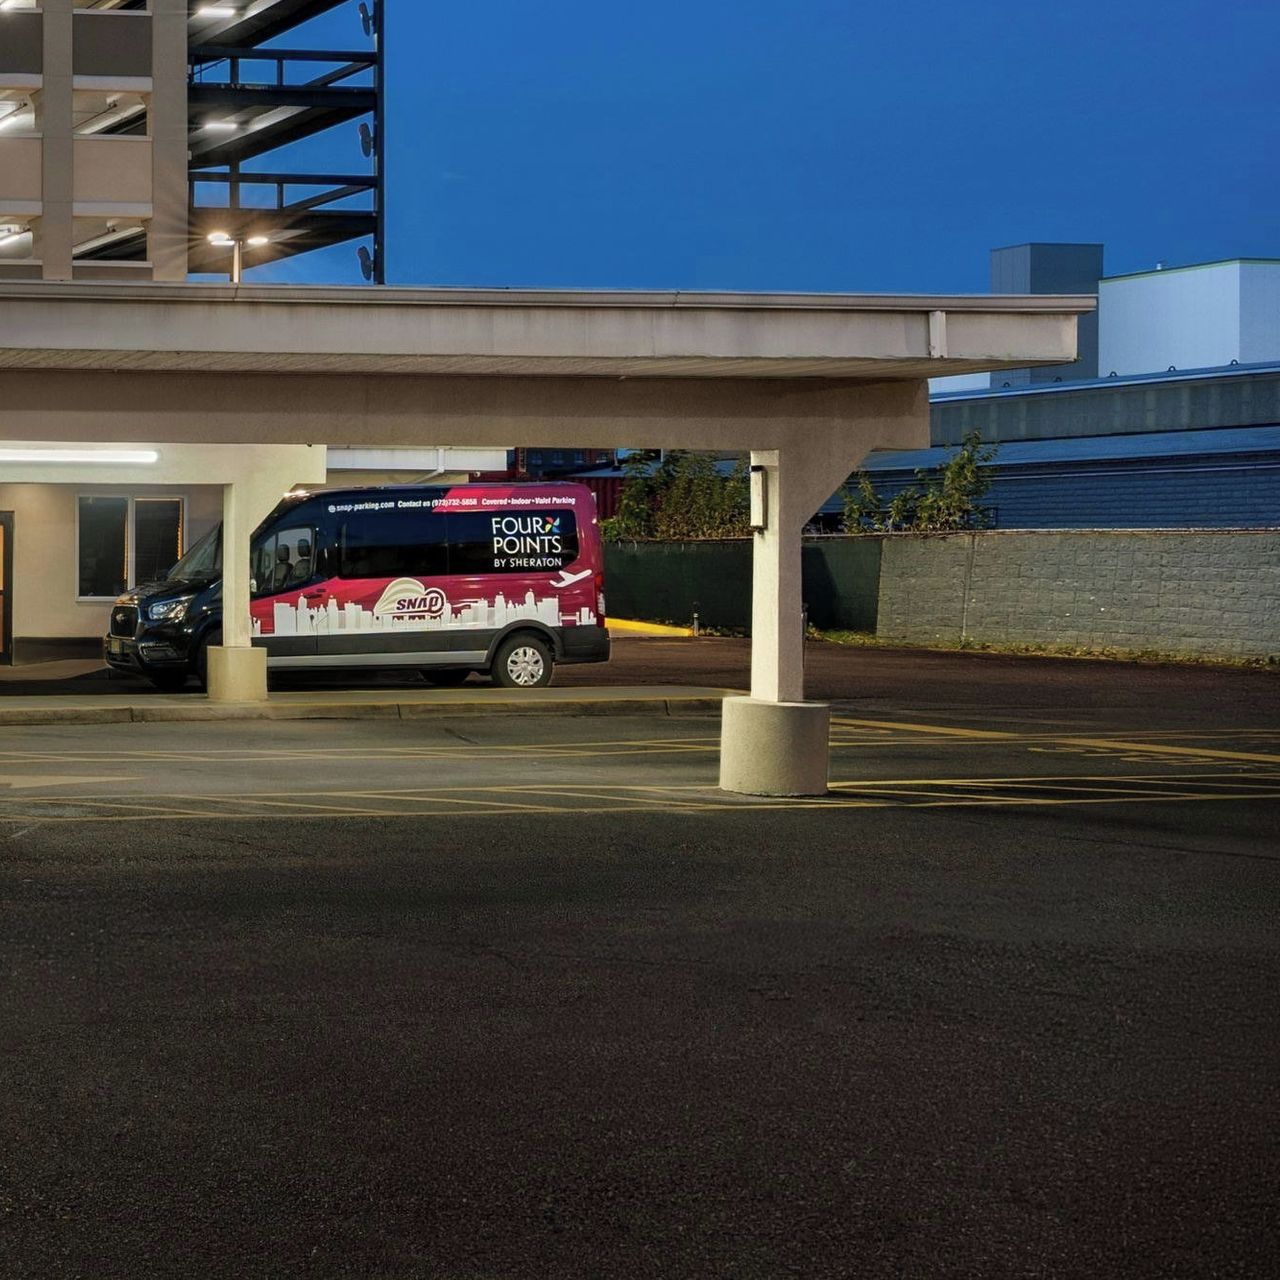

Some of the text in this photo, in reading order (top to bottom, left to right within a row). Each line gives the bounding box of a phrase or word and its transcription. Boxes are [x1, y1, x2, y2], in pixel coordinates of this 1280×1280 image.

[397, 500, 422, 508] Contact
[552, 496, 576, 506] Parking
[491, 517, 545, 535] FOUR
[493, 535, 562, 554] POINTS
[494, 557, 562, 567] BY SHERATON
[396, 596, 439, 611] SNAP
